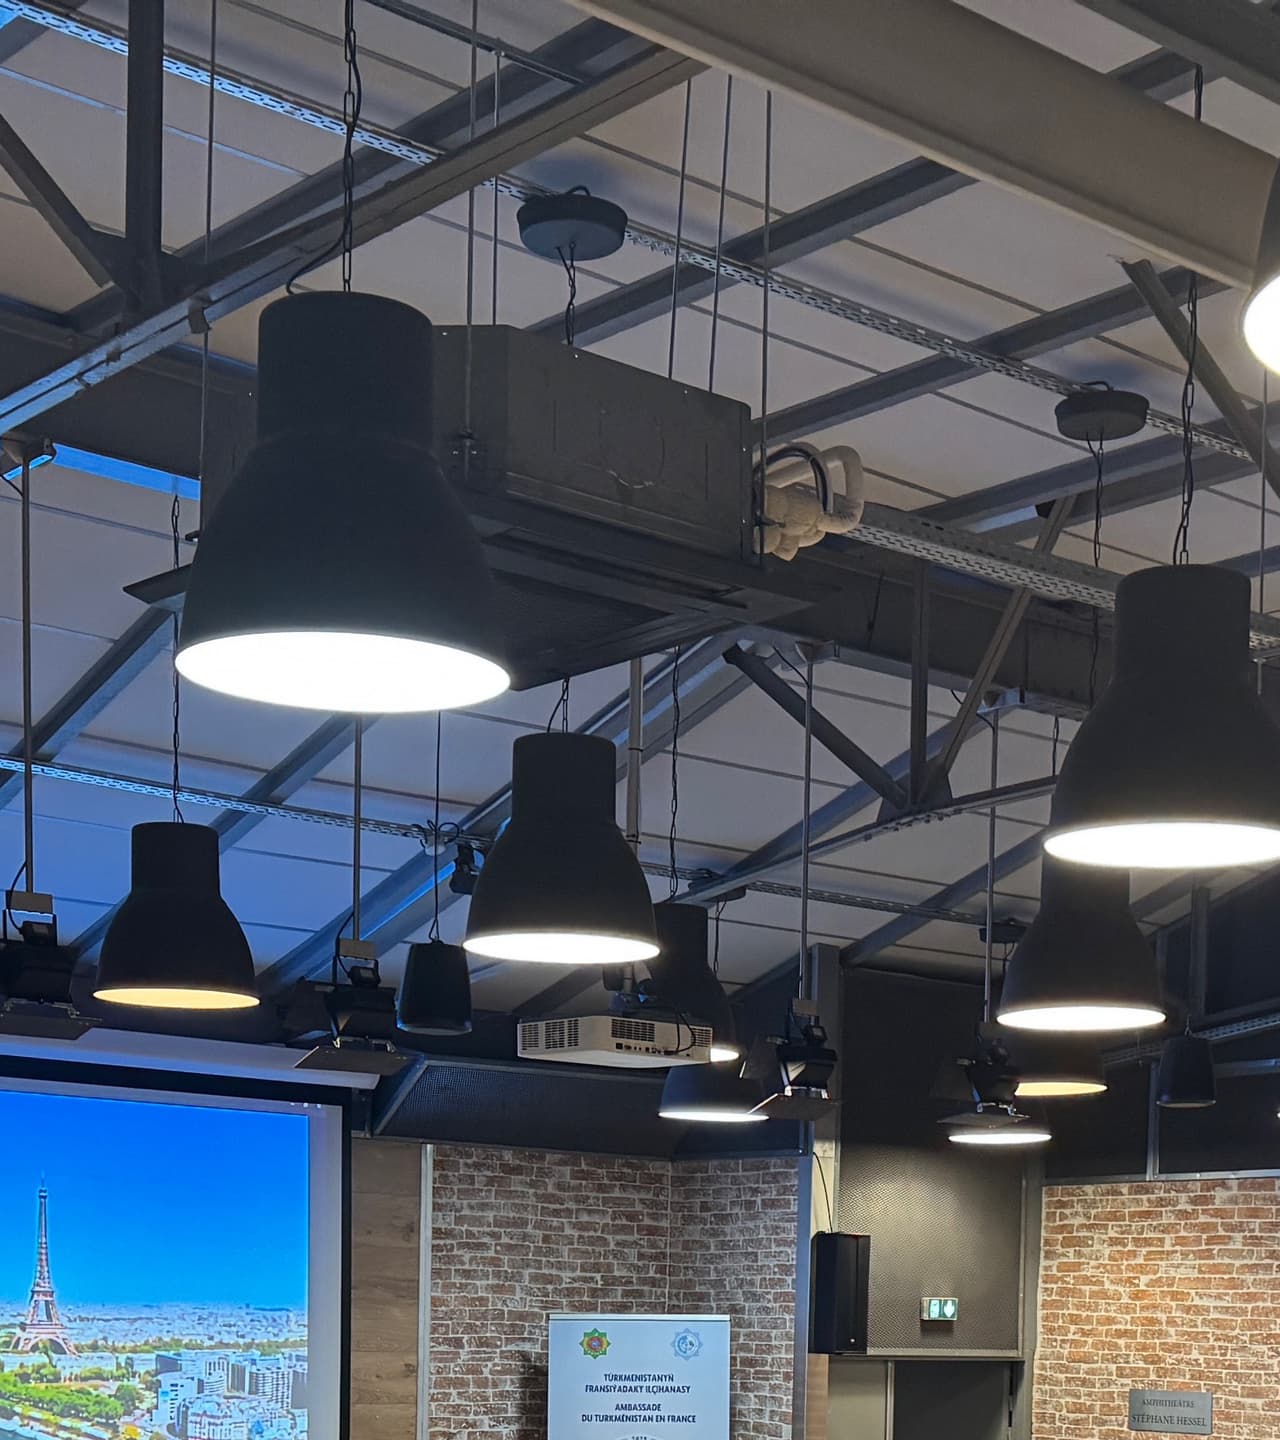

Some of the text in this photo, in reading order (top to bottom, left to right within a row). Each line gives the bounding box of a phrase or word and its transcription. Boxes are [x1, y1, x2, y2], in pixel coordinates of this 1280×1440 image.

[615, 1403, 662, 1412] AMBASSADE
[581, 1414, 593, 1422] DU
[655, 1414, 665, 1423] EN
[667, 1414, 697, 1423] FRANCE
[1176, 1415, 1207, 1427] HESSEL
